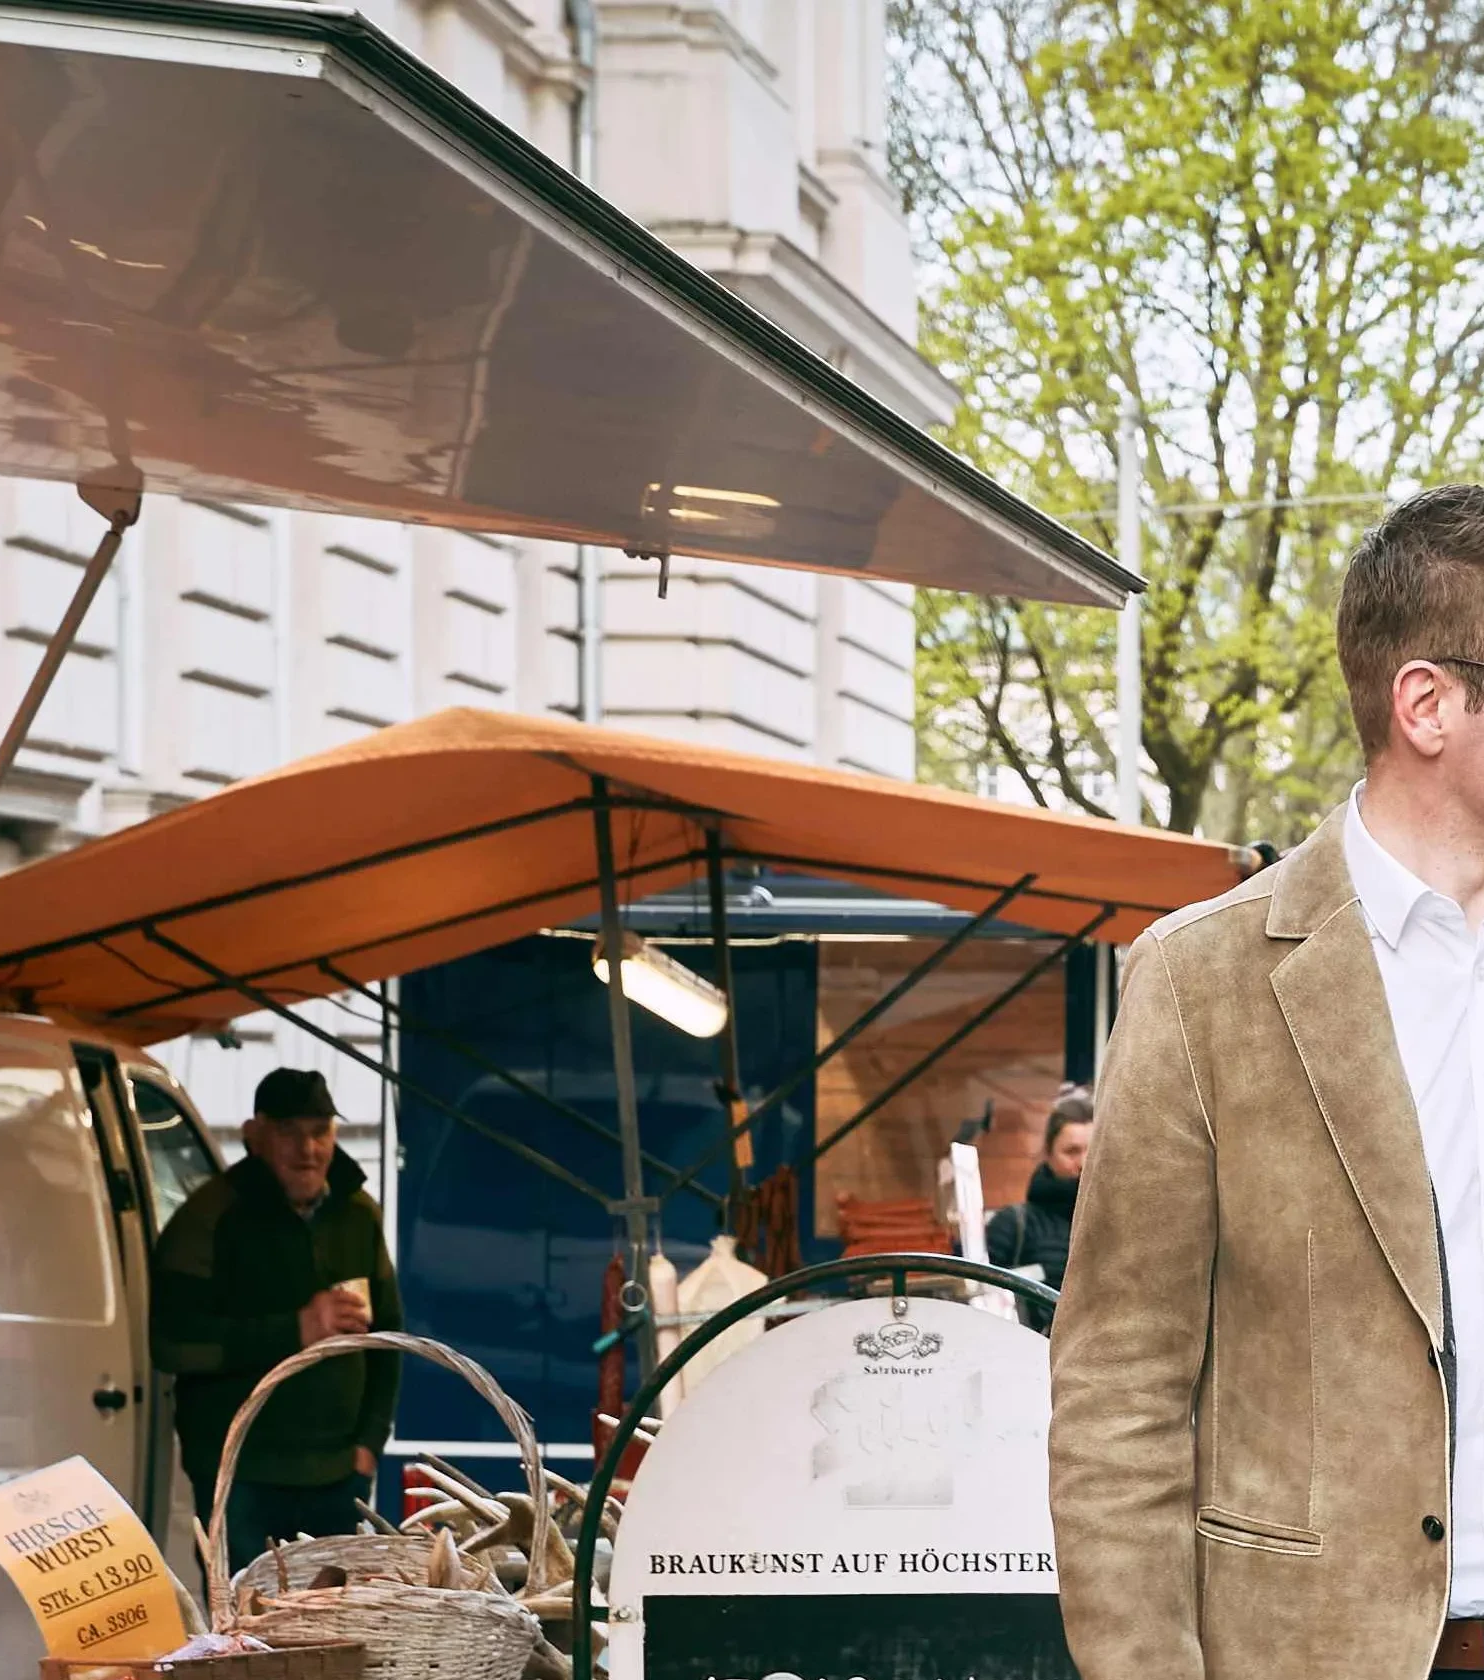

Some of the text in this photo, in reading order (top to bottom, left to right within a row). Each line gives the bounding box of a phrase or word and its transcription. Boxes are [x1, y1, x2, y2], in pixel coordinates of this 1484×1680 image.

[863, 1365, 934, 1378] Salzburger
[4, 1504, 106, 1553] HIRSCH-
[25, 1525, 116, 1574] WURST
[649, 1548, 1054, 1574] BRAUKUNST AUF HÖCHSTER
[38, 1588, 80, 1614] STK.
[76, 1622, 106, 1645] CA.
